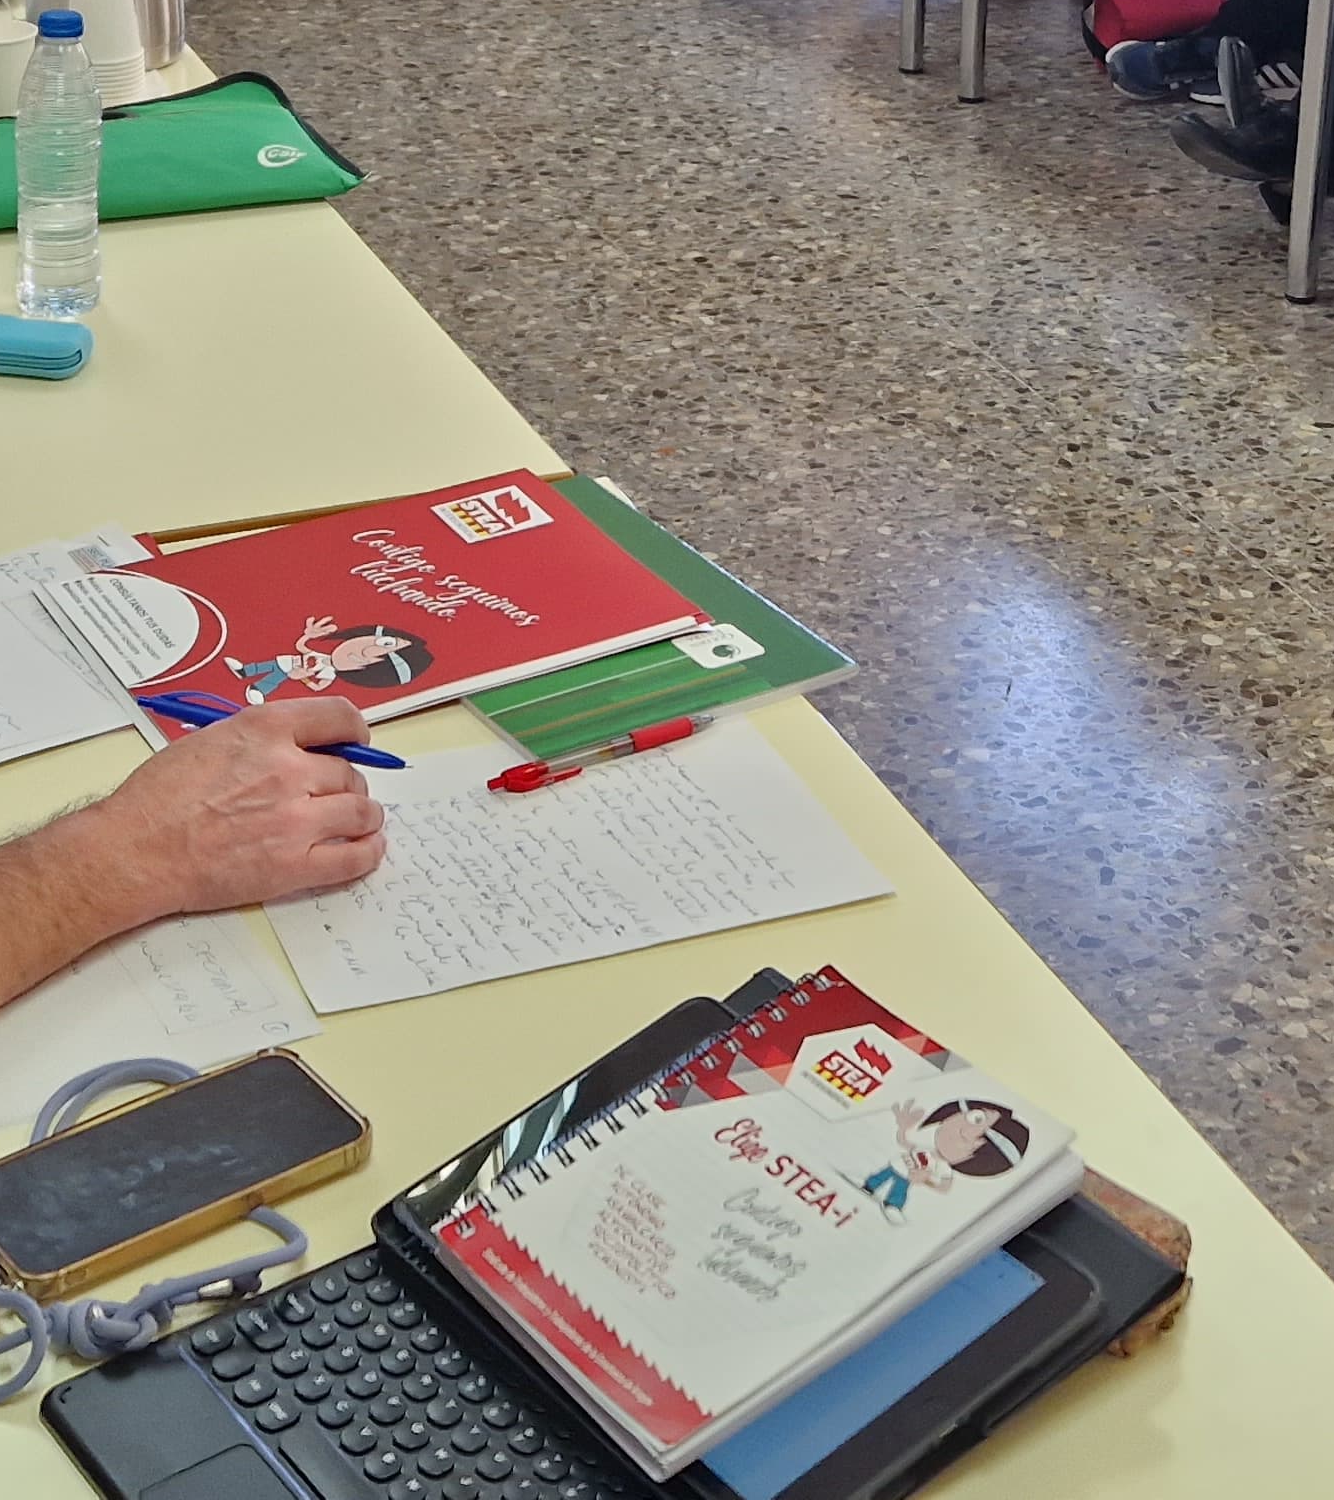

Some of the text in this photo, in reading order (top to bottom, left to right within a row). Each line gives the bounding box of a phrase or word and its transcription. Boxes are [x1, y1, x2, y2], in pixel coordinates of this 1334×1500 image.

[460, 499, 505, 534] STEA
[350, 560, 467, 622] luchando.
[352, 529, 540, 627] Contigo seguimos
[824, 1055, 872, 1093] STEA
[714, 1118, 858, 1228] Elige STEA-i
